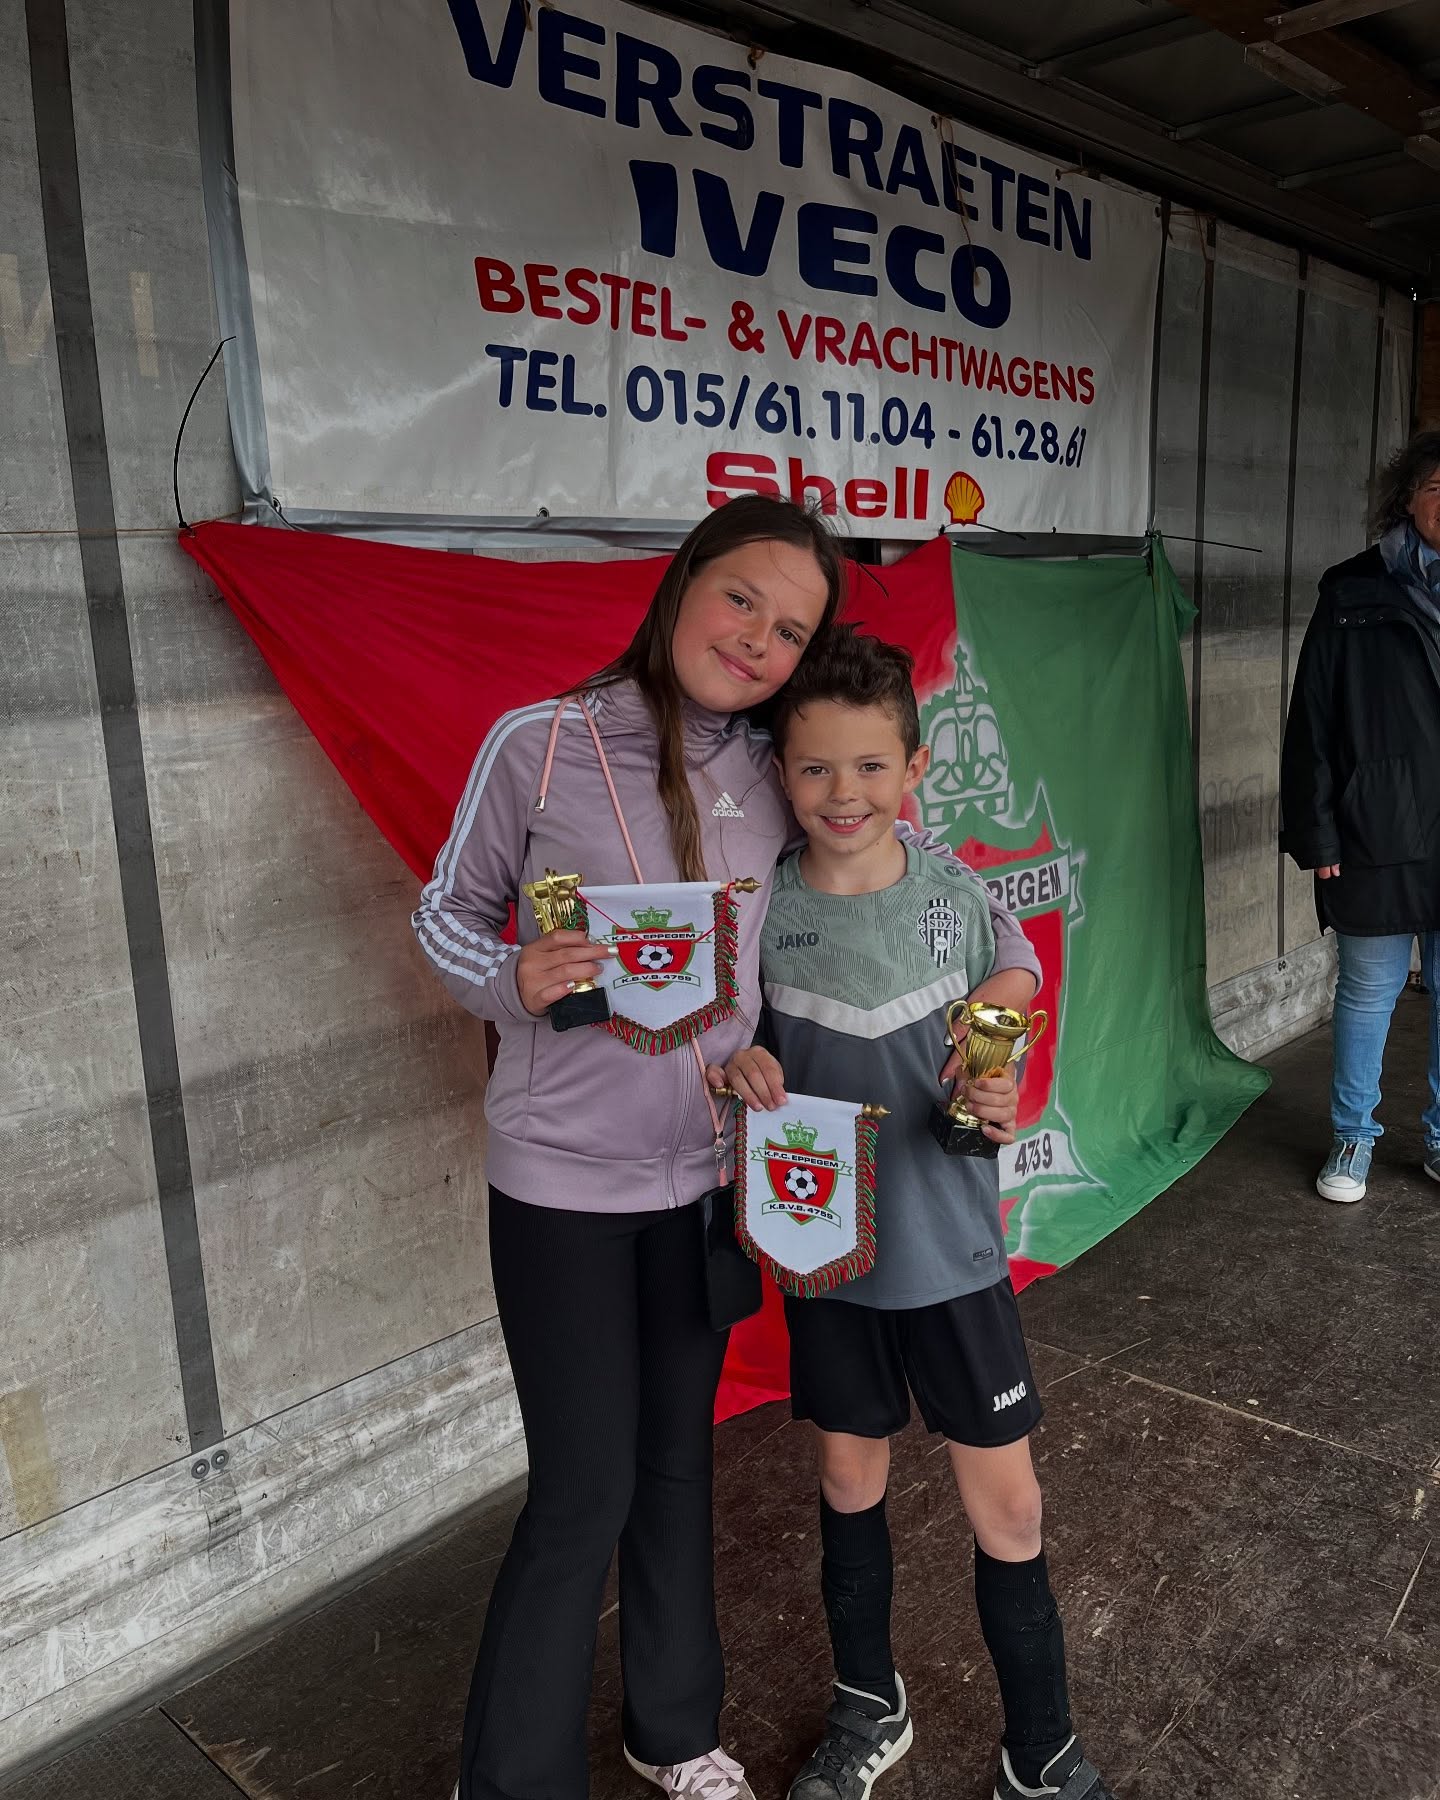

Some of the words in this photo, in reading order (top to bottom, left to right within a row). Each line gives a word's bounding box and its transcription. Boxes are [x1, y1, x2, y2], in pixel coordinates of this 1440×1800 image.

[447, 0, 1093, 261] VERSTRAETEN
[629, 159, 1011, 329] IVECO
[474, 256, 707, 342] BESTEL-
[727, 300, 765, 354] &
[777, 309, 1096, 405] VRACHTWAGENS
[484, 343, 608, 418] TEL.
[625, 365, 936, 449] 015/61.11.04
[971, 413, 1087, 468] 61.28.61
[706, 451, 930, 521] Shell
[712, 807, 745, 818] adidas
[929, 919, 953, 929] SDZ
[775, 931, 821, 951] JAKO
[764, 1150, 790, 1159] K.F.C.
[791, 1153, 839, 1168] EPPEGEM
[807, 1207, 834, 1220] 4759
[993, 1380, 1027, 1412] JAKO
